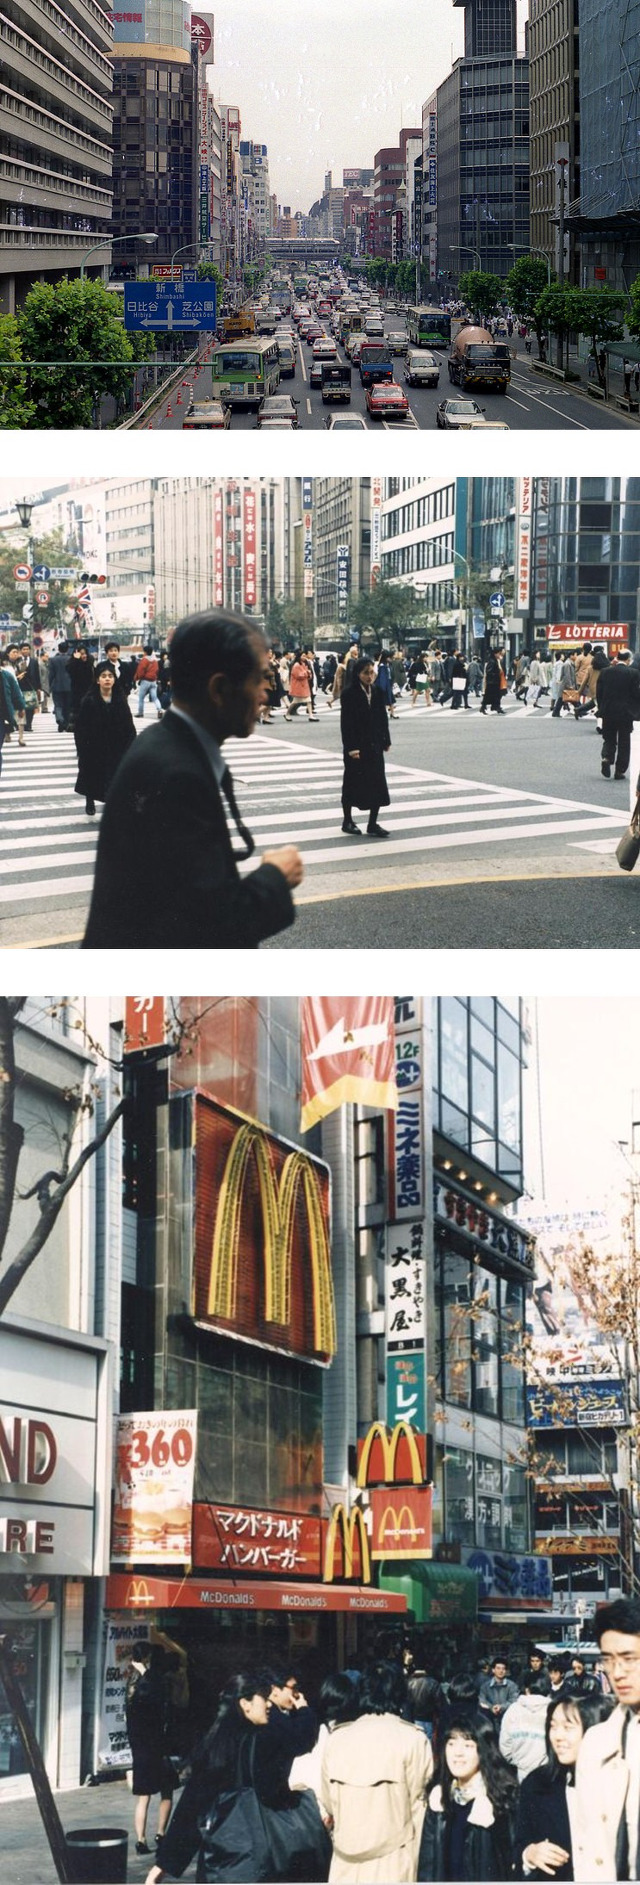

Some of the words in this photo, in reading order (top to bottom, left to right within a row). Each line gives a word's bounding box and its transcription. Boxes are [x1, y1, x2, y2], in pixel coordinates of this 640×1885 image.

[155, 283, 185, 293] 新橋
[127, 301, 158, 312] 日比谷
[182, 301, 214, 312] 芝公園
[565, 625, 624, 638] LOTTERIA
[396, 1101, 420, 1209] ミネ薬品
[390, 1246, 413, 1332] 大黒屋
[216, 1510, 303, 1542] マクドナルド
[220, 1544, 308, 1569] ハンバーガー
